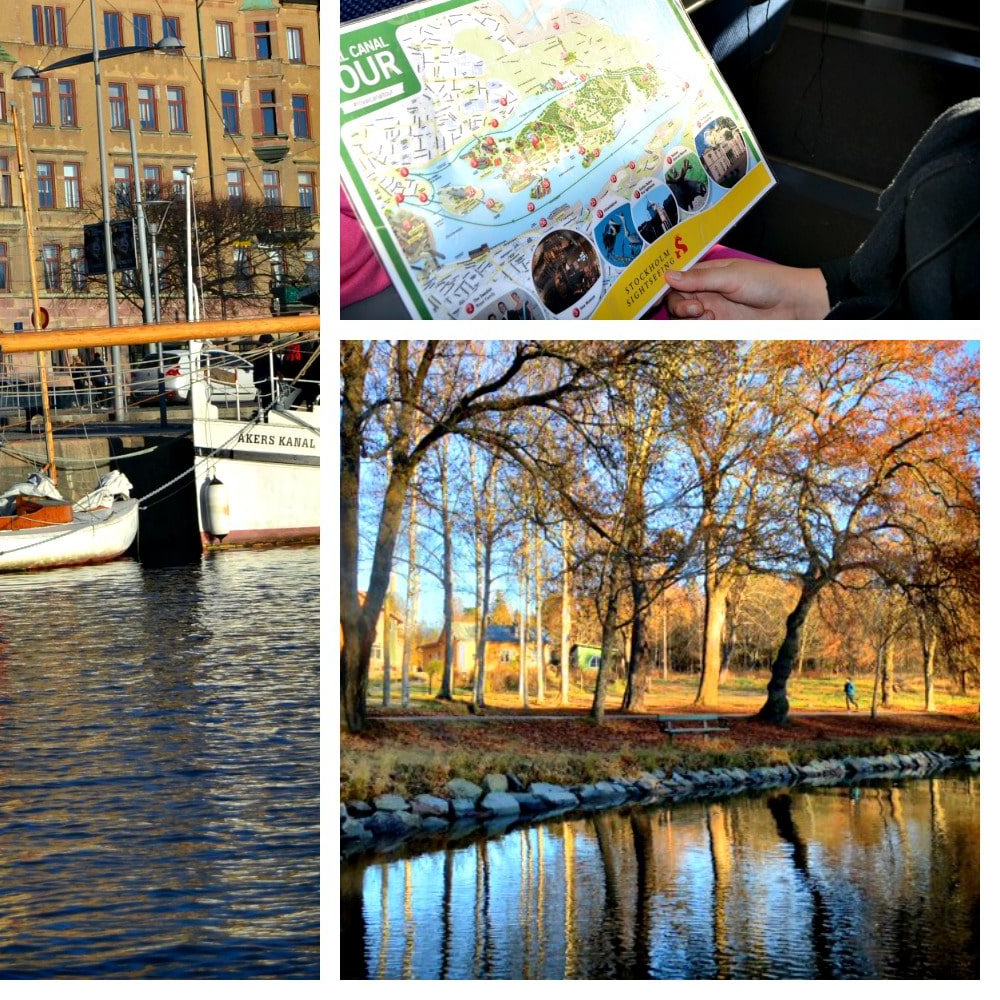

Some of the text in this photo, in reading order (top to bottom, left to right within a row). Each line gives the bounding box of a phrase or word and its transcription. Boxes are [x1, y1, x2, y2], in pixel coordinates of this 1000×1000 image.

[349, 36, 390, 58] CANAL
[625, 249, 671, 295] STOCKHOLM
[626, 257, 676, 307] SIGHTSEEING
[278, 436, 316, 449] KANAL
